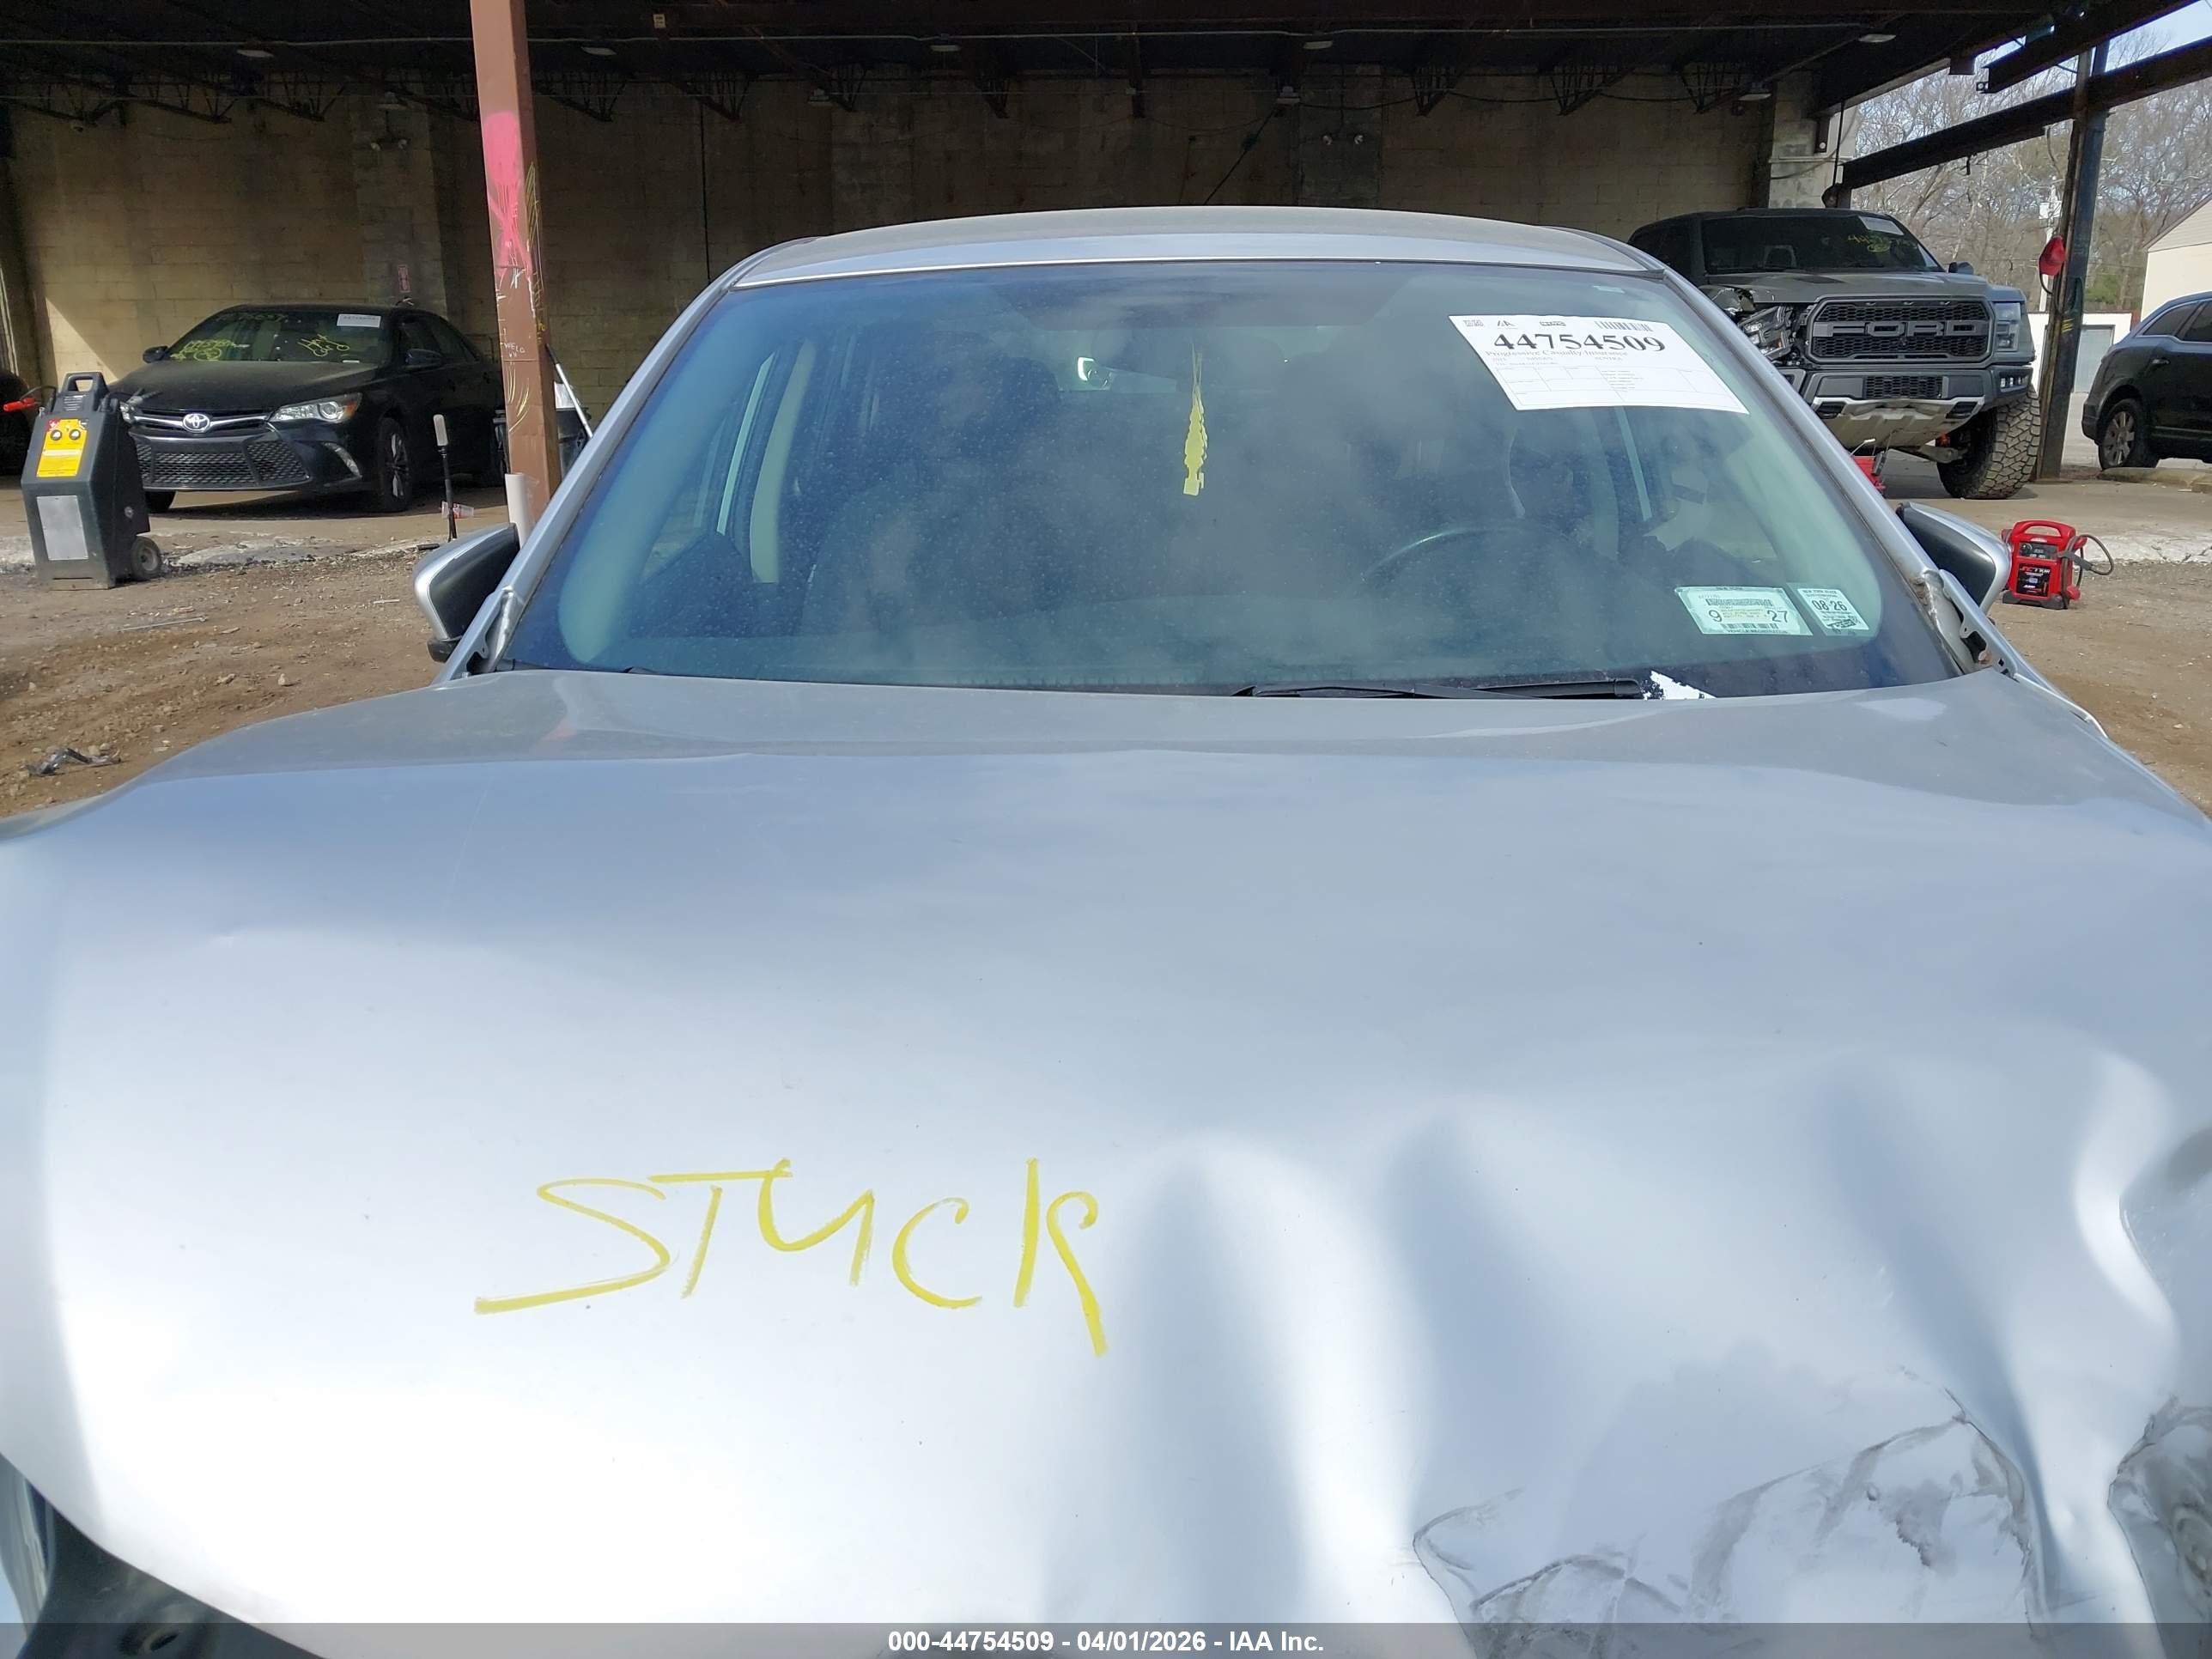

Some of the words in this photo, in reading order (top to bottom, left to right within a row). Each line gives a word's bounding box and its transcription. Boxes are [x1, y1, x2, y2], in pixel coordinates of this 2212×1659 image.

[1813, 320, 1990, 337] FORD
[1493, 333, 1666, 352] 44754509
[1541, 349, 1582, 358] Casualty
[1708, 610, 1723, 623] 9
[1766, 610, 1788, 623] 27
[474, 1158, 1109, 1357] STUCK
